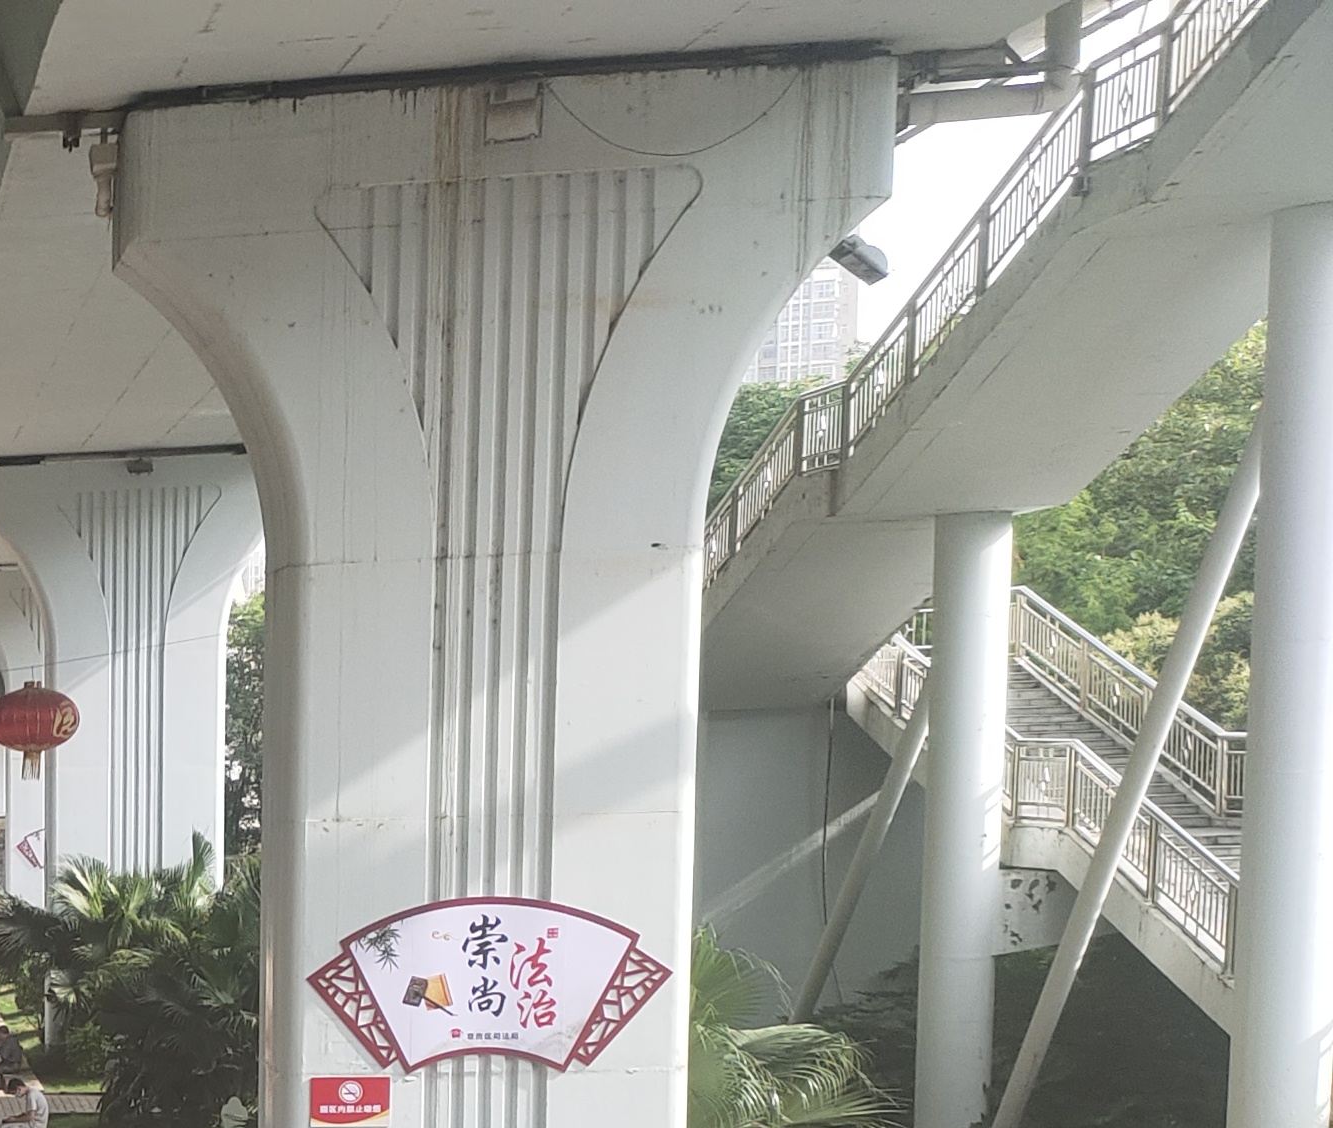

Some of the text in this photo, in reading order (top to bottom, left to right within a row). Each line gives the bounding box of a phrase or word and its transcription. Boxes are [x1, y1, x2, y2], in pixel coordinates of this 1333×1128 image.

[53, 701, 79, 738] 园
[461, 914, 509, 1018] 崇尚
[509, 937, 558, 1030] 法治
